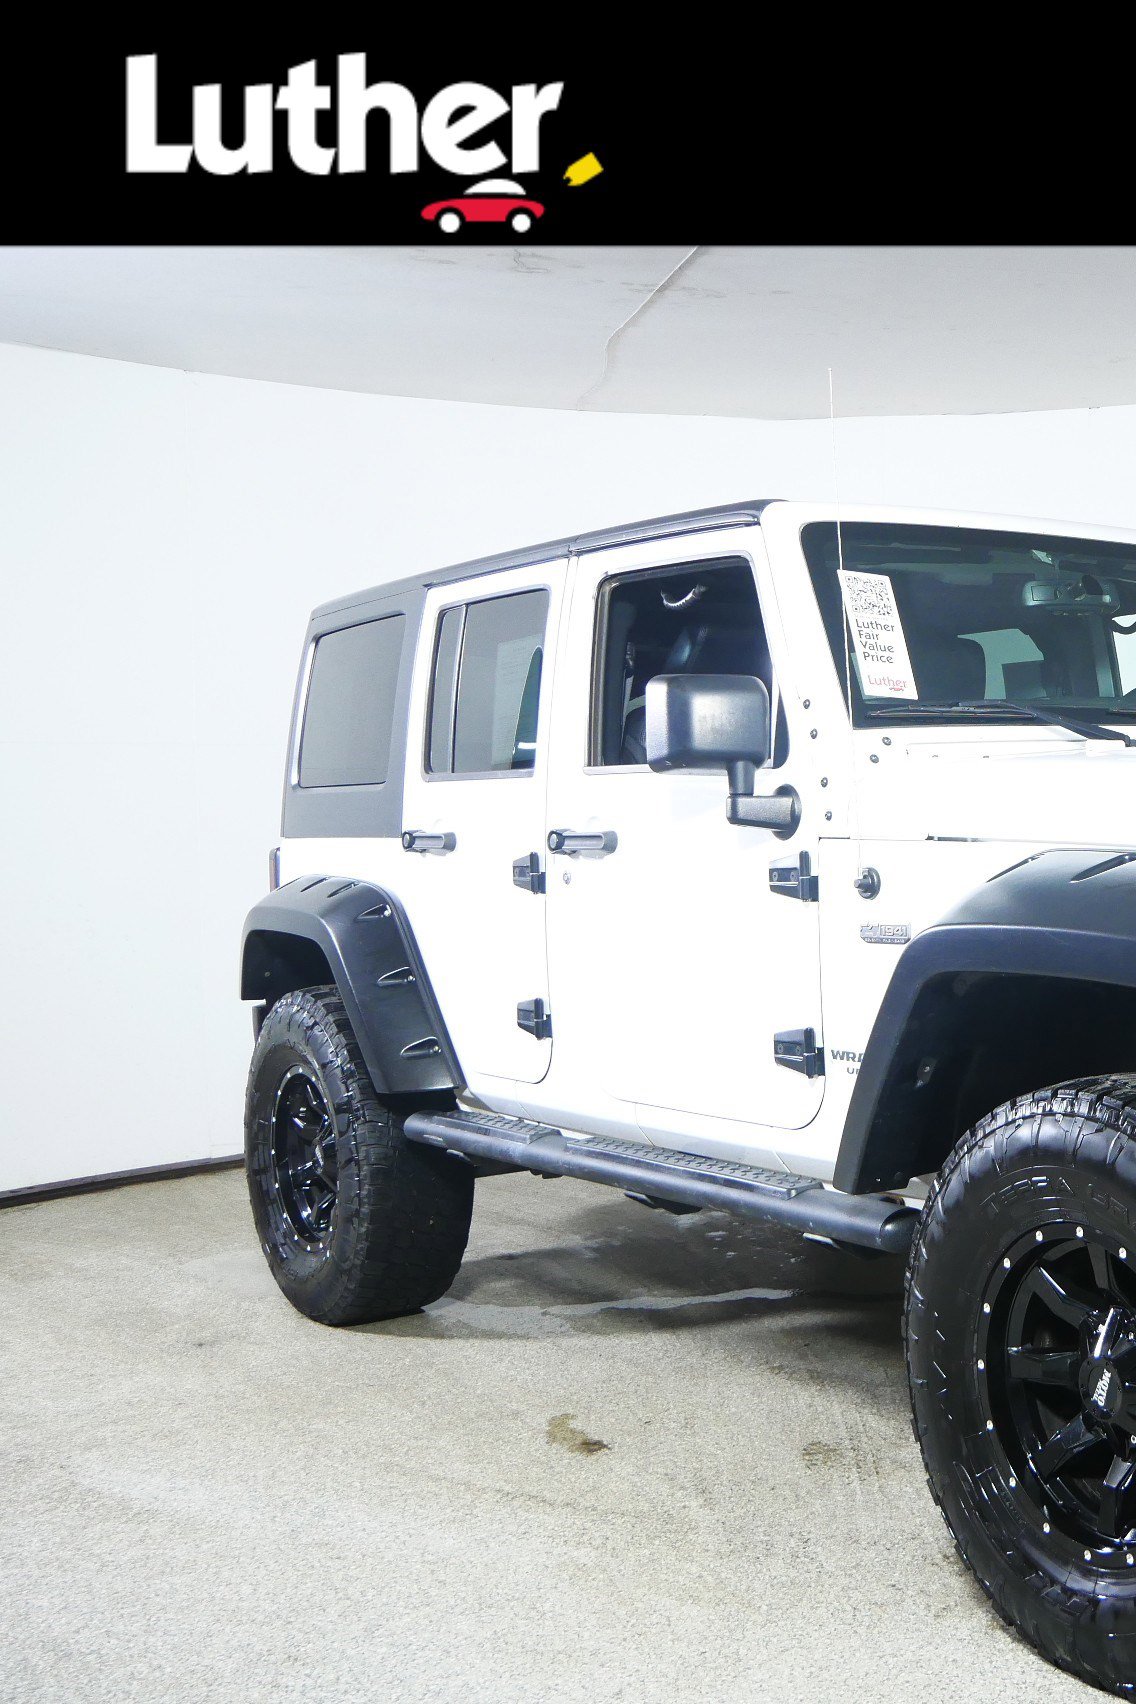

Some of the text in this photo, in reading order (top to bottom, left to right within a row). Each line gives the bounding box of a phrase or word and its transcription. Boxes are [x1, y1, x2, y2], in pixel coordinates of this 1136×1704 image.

[856, 619, 895, 632] Luther
[858, 630, 880, 641] Fair
[860, 640, 895, 653] Value
[863, 651, 894, 664] Price
[868, 675, 907, 688] Luther
[880, 925, 907, 937] 1941
